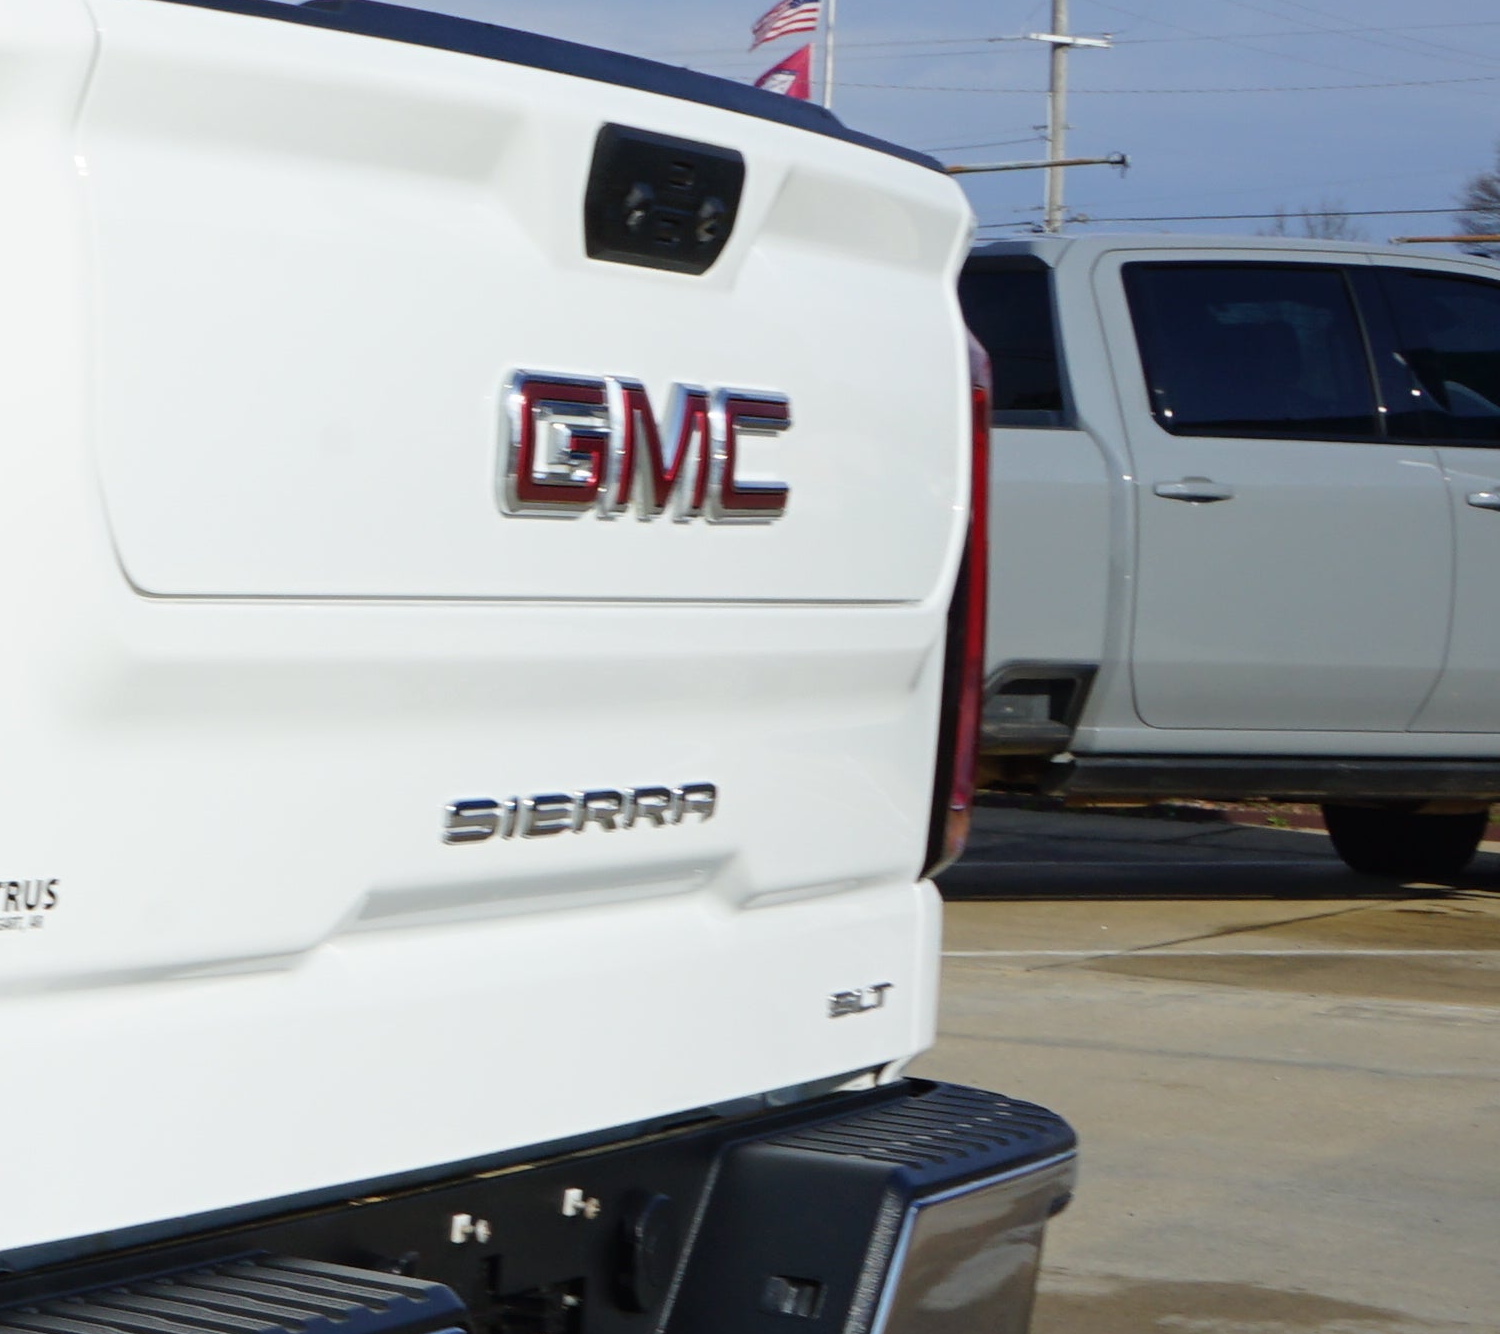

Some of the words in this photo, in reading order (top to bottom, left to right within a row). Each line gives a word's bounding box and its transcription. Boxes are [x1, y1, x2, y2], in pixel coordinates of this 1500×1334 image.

[496, 368, 792, 523] GMC
[442, 782, 717, 844] SIERRA
[827, 981, 893, 1018] SLT
